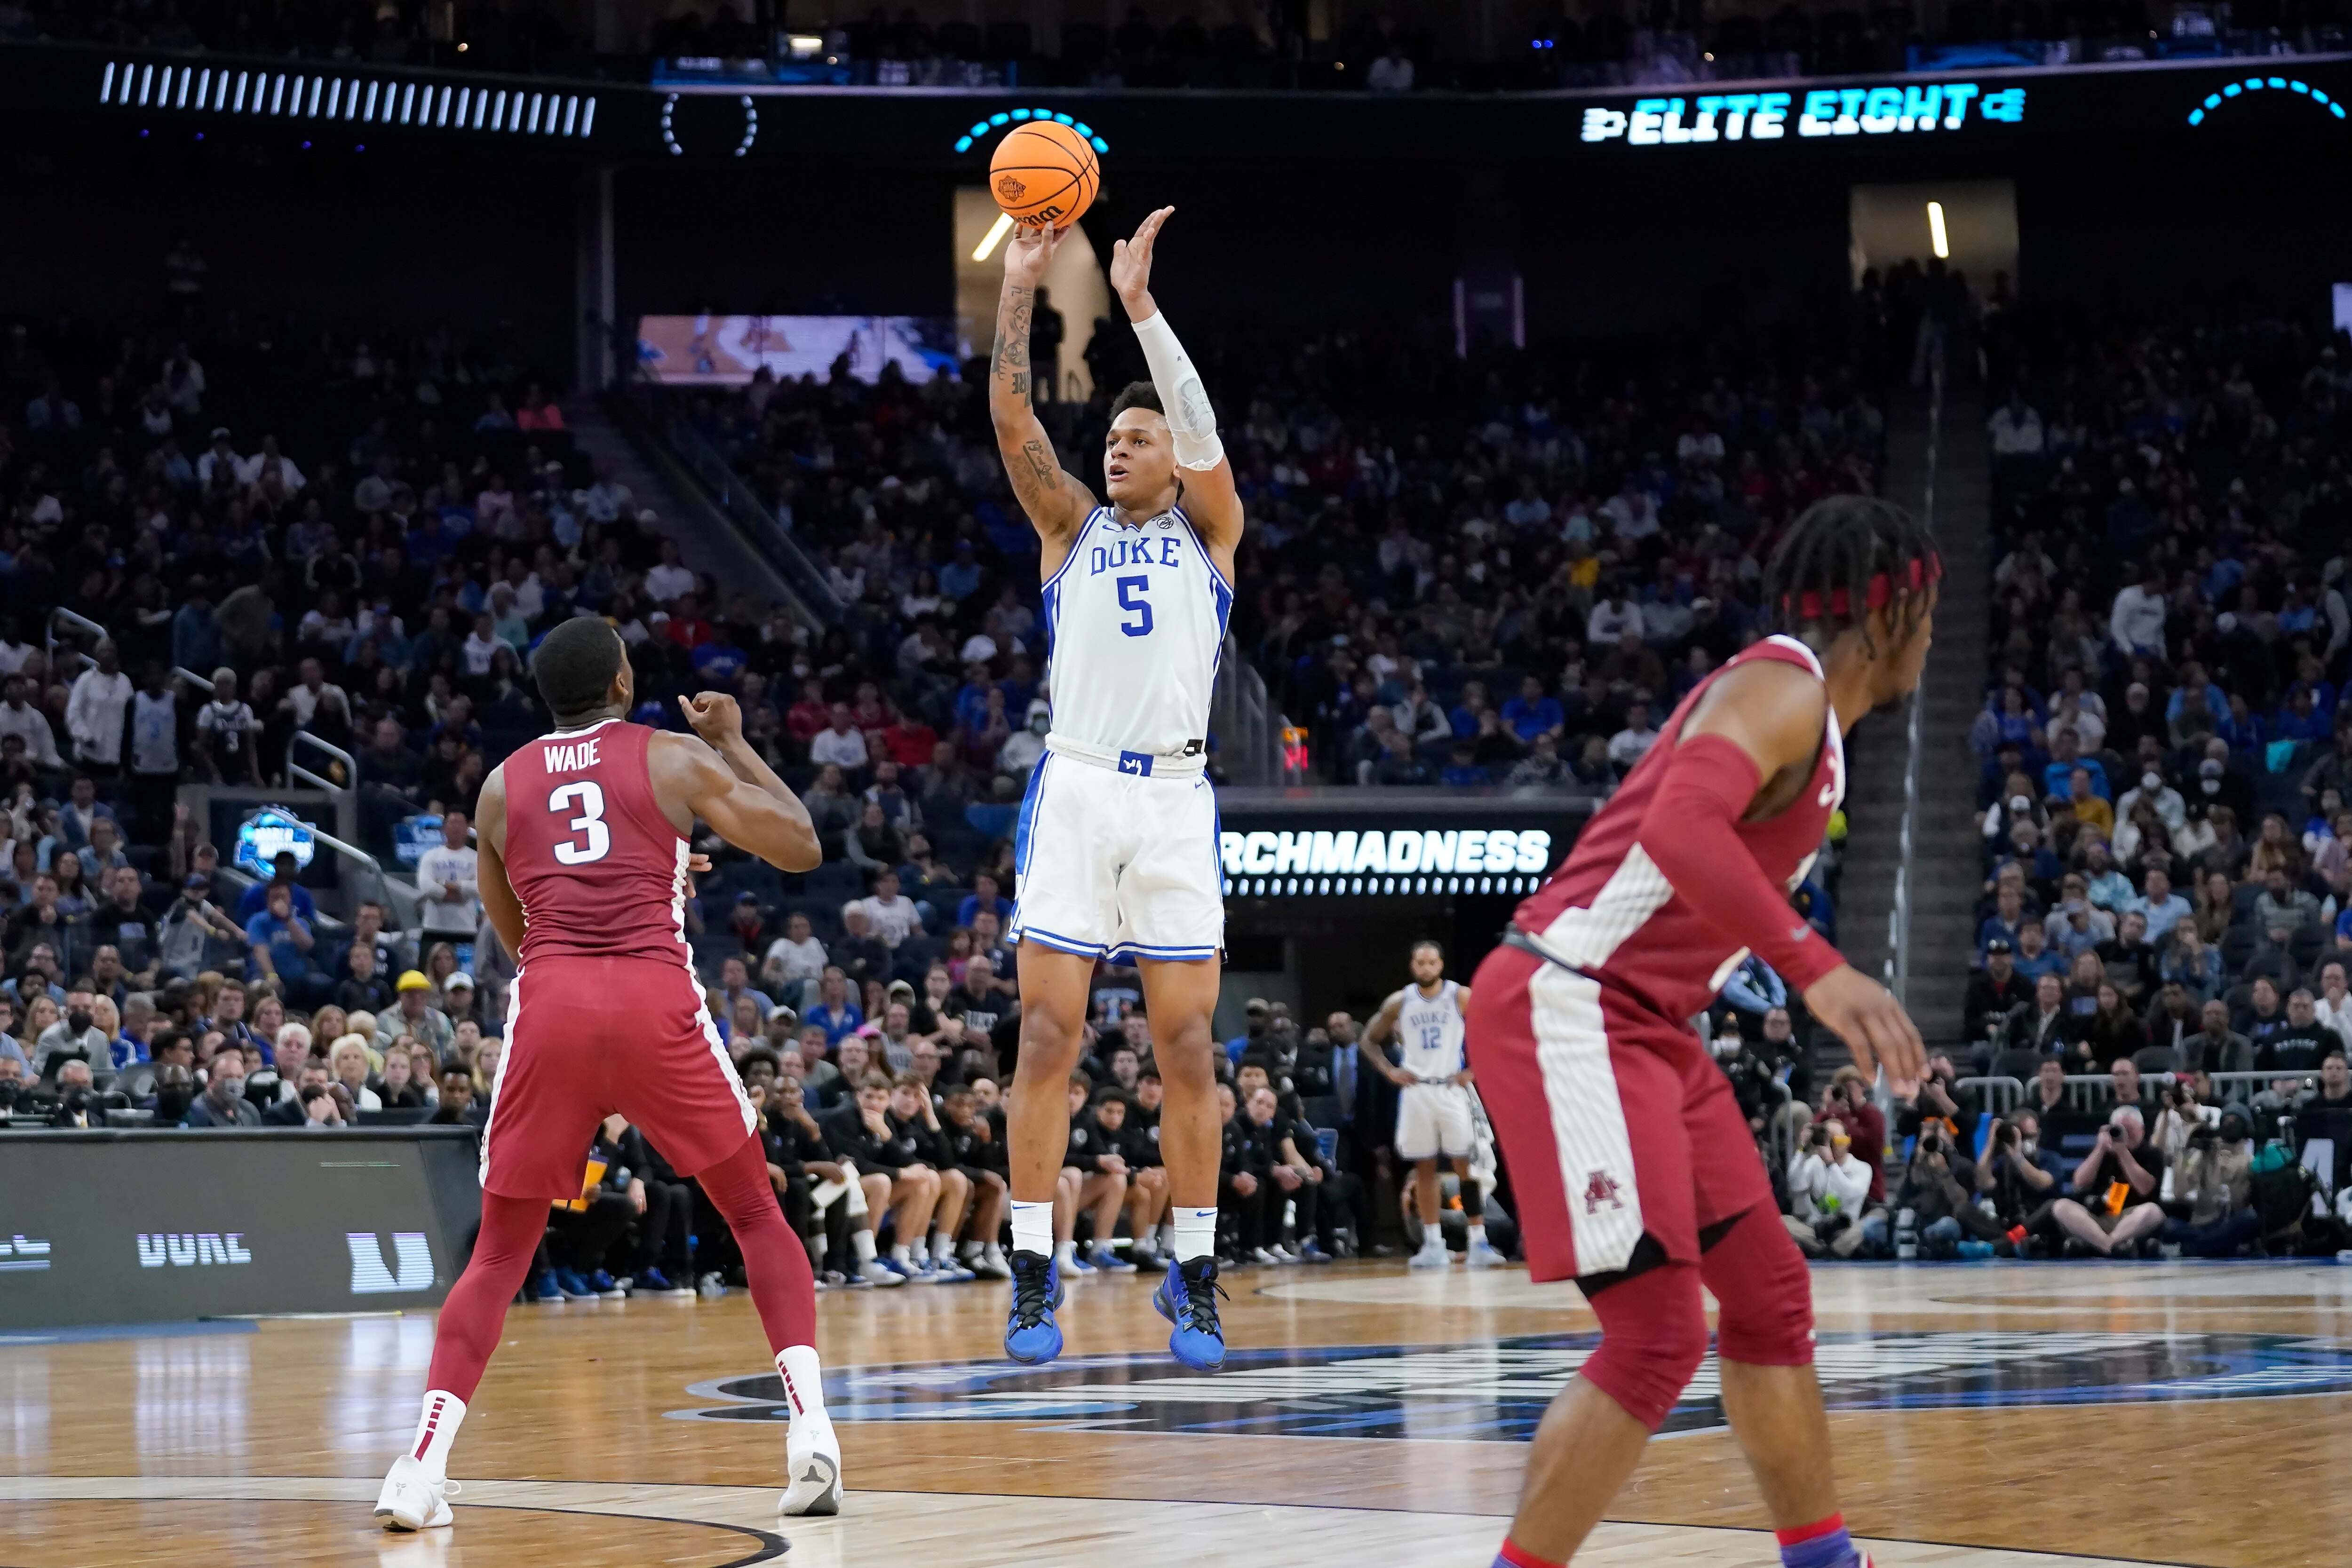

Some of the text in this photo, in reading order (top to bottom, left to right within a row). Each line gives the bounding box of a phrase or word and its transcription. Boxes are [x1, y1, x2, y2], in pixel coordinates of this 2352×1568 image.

[1628, 83, 1979, 145] ELITE EIGHT
[1091, 537, 1181, 576] DUKE
[1117, 575, 1153, 637] 5
[544, 737, 601, 774] WADE
[548, 781, 610, 866] 3
[1410, 1012, 1450, 1027] DUKE
[1422, 1026, 1441, 1049] 12
